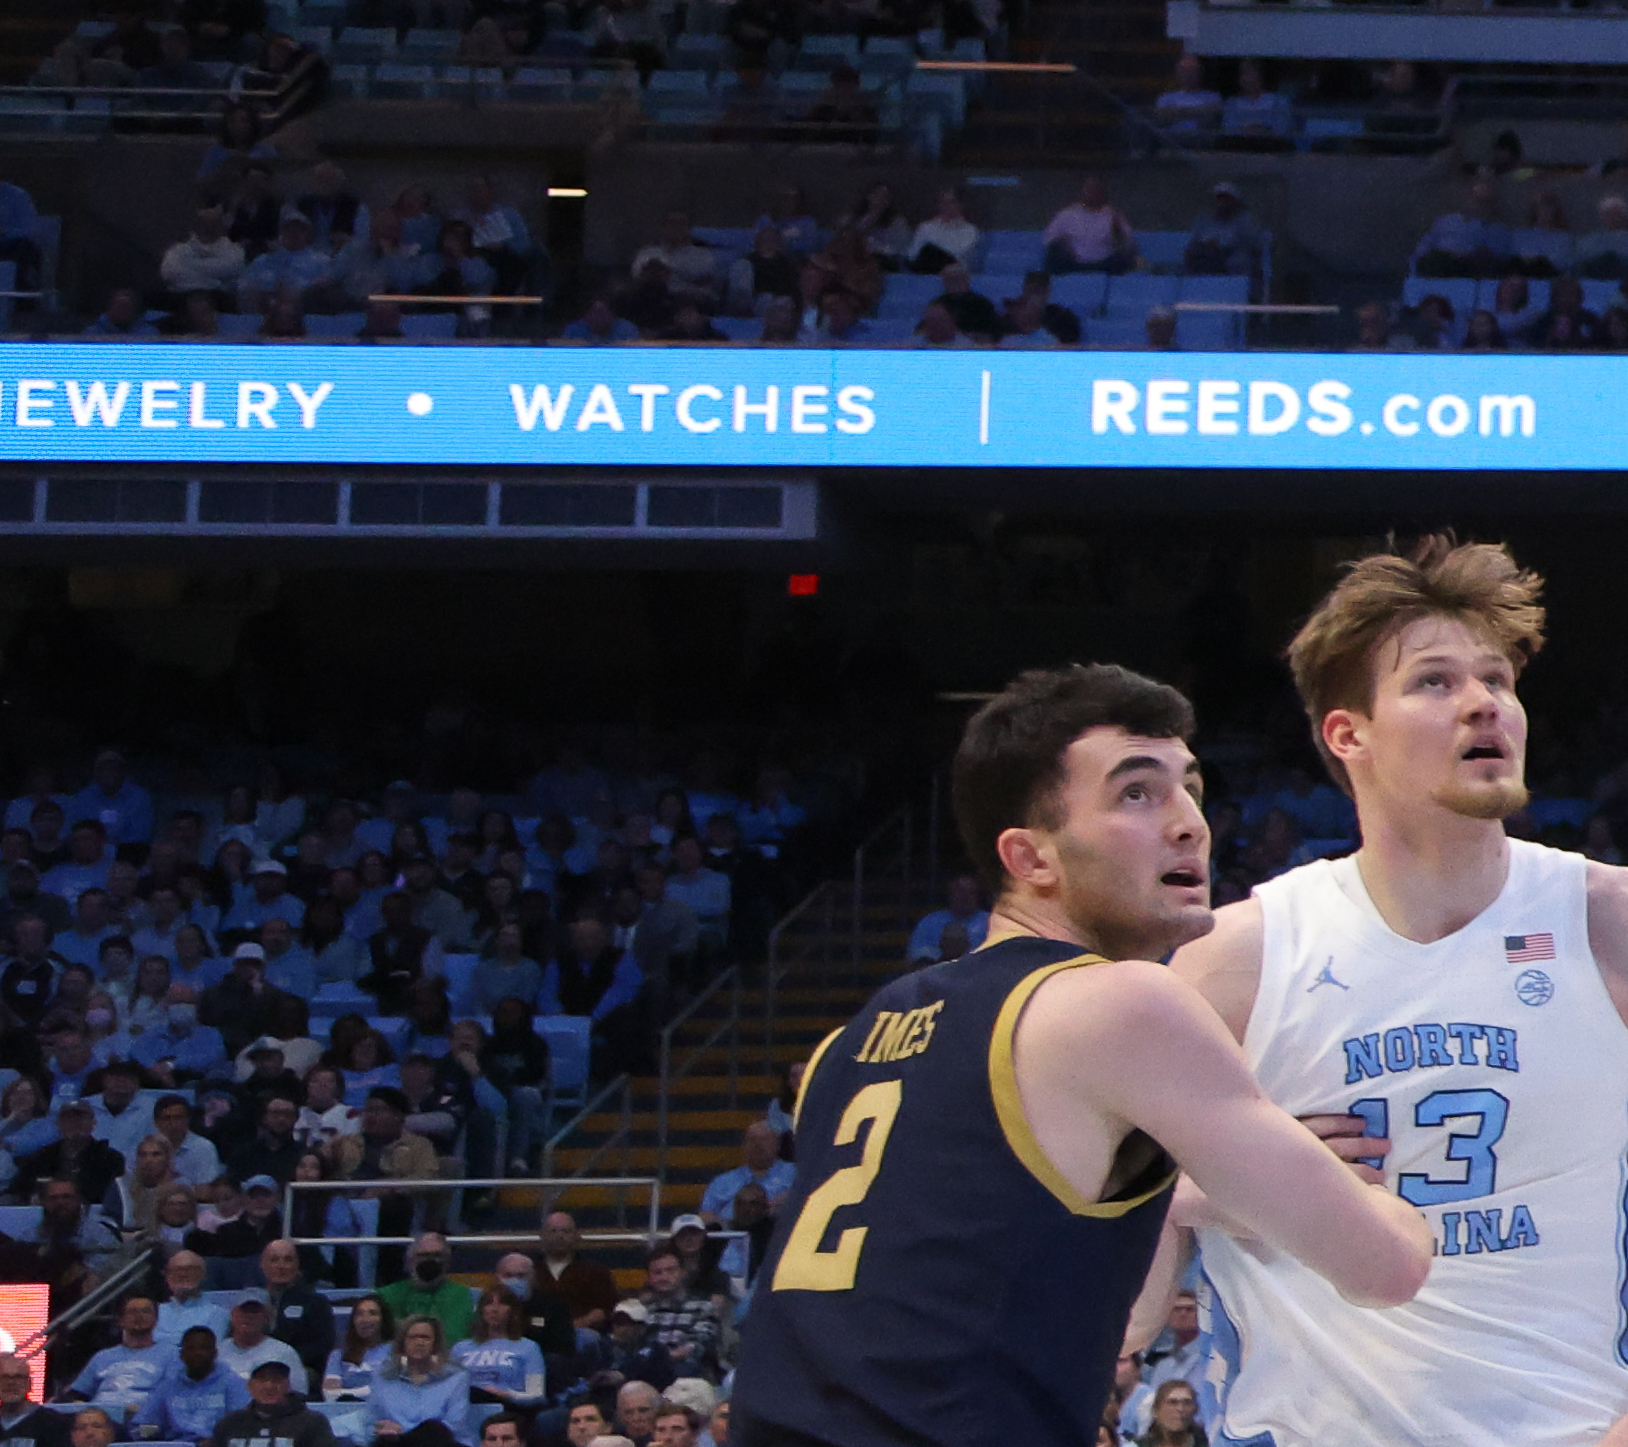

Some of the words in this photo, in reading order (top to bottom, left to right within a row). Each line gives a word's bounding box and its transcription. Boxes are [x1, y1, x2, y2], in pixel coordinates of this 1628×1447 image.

[0, 380, 333, 429] EWELRY
[510, 383, 876, 434] WATCHES
[1092, 378, 1537, 438] REEDS.com
[1344, 1022, 1519, 1085] NORTH
[773, 1078, 902, 1292] 2
